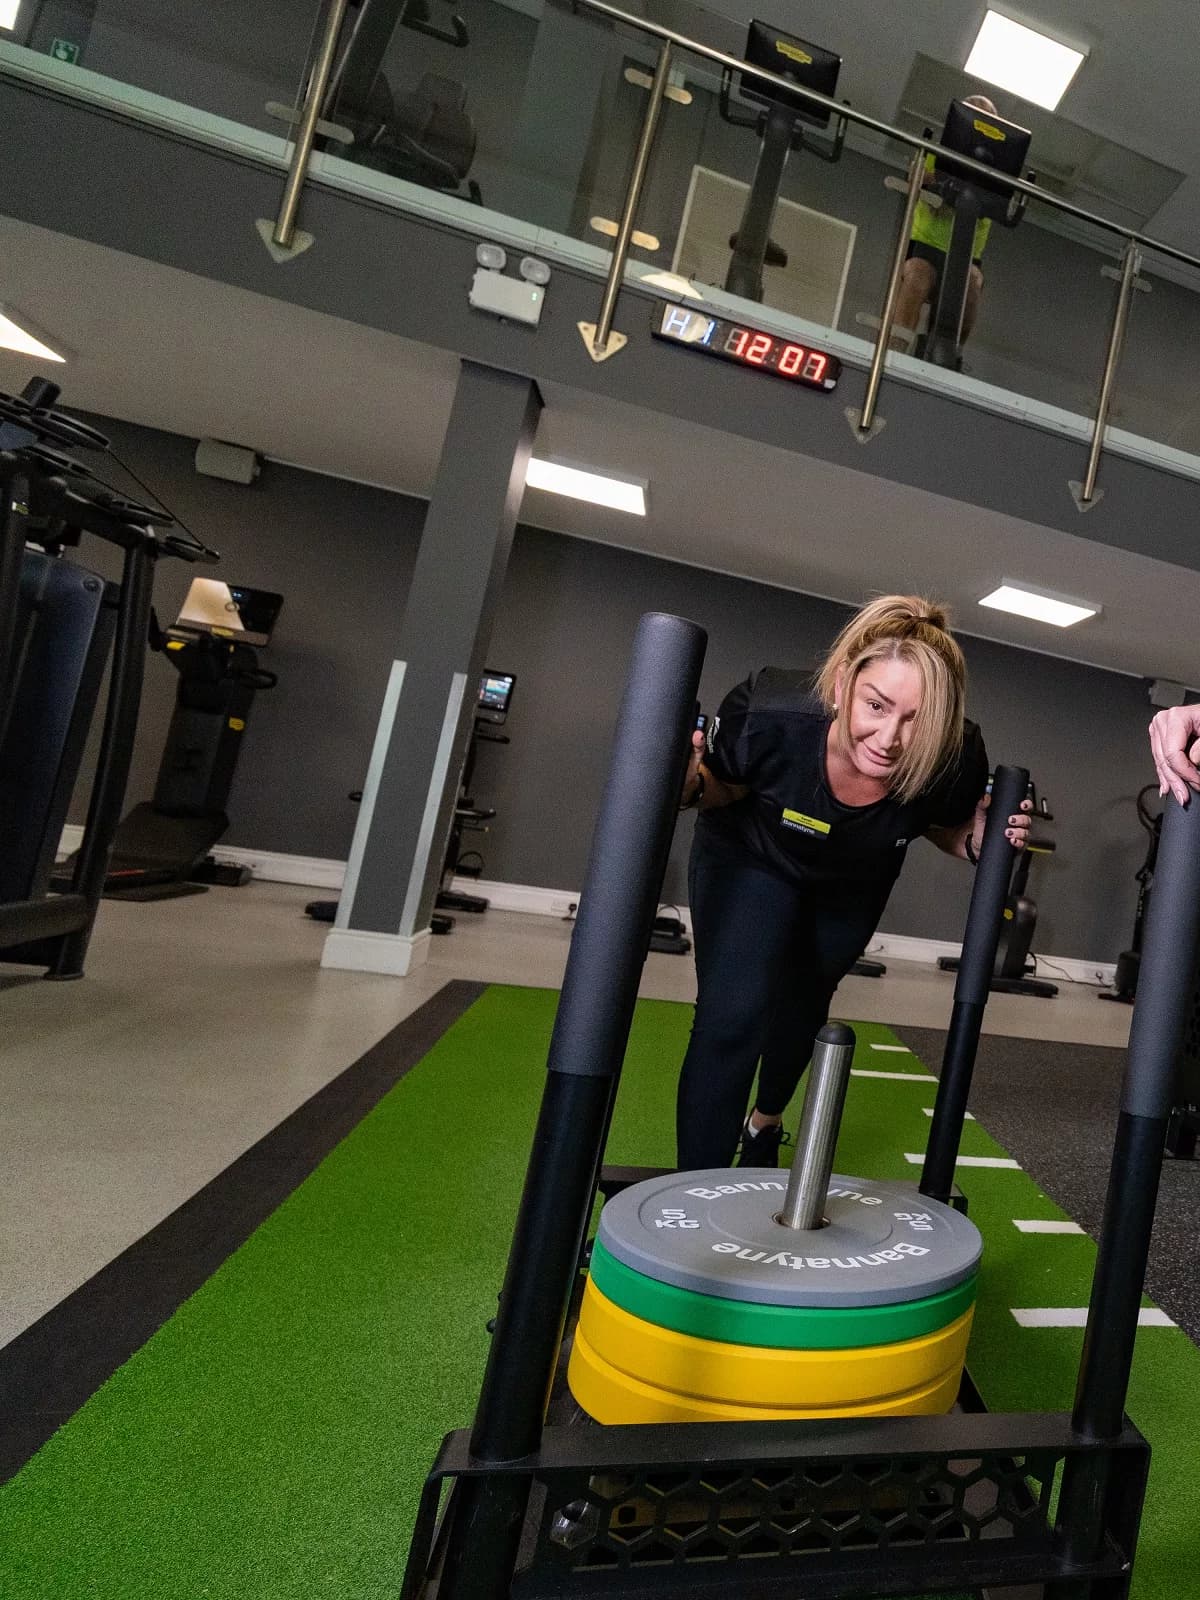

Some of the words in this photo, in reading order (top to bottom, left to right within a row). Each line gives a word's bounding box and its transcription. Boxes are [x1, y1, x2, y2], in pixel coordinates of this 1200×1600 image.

[684, 1181, 883, 1206] Bannne
[661, 1208, 687, 1219] 5
[655, 1219, 700, 1229] KG
[711, 1242, 931, 1270] Bannatyne
